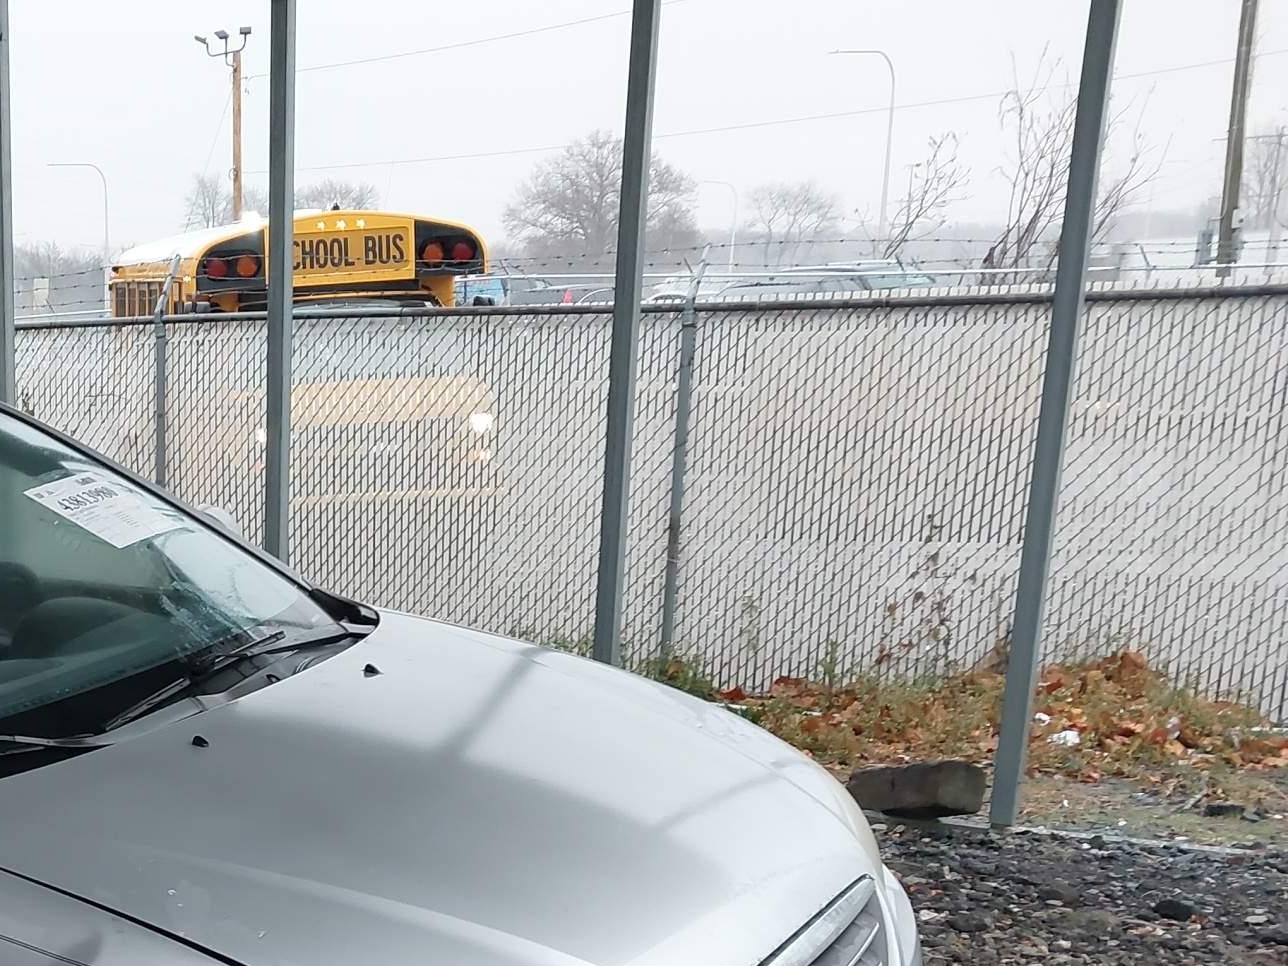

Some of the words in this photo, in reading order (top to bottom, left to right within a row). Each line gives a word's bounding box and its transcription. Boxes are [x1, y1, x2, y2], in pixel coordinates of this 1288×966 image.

[292, 237, 355, 270] CHOOL
[364, 234, 405, 265] BUS
[57, 486, 118, 511] 43813980
